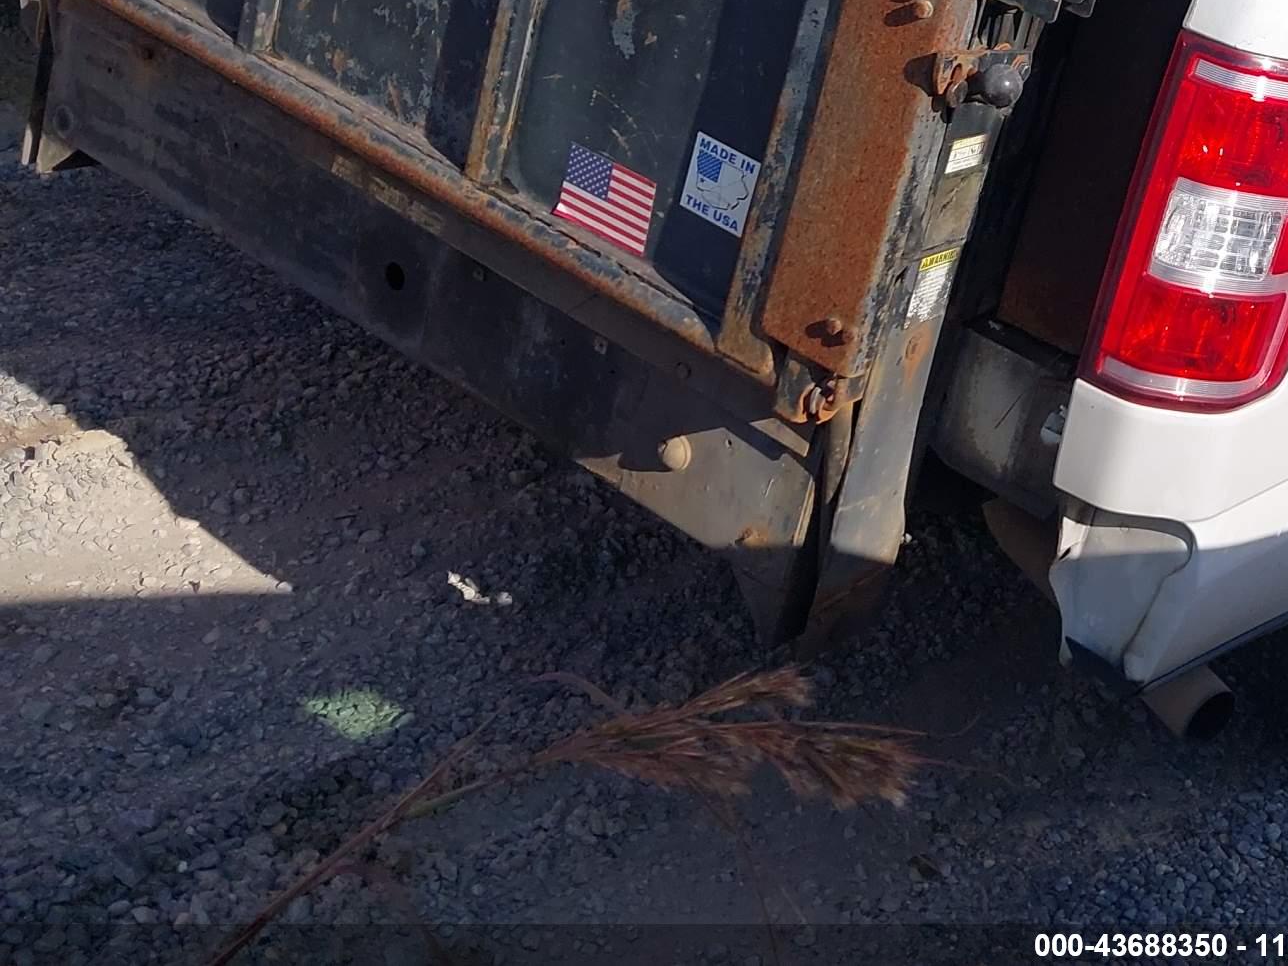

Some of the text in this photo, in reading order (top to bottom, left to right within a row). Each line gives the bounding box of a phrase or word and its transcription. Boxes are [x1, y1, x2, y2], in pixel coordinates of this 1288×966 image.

[700, 137, 756, 175] MADE IN
[686, 194, 739, 232] THE USA
